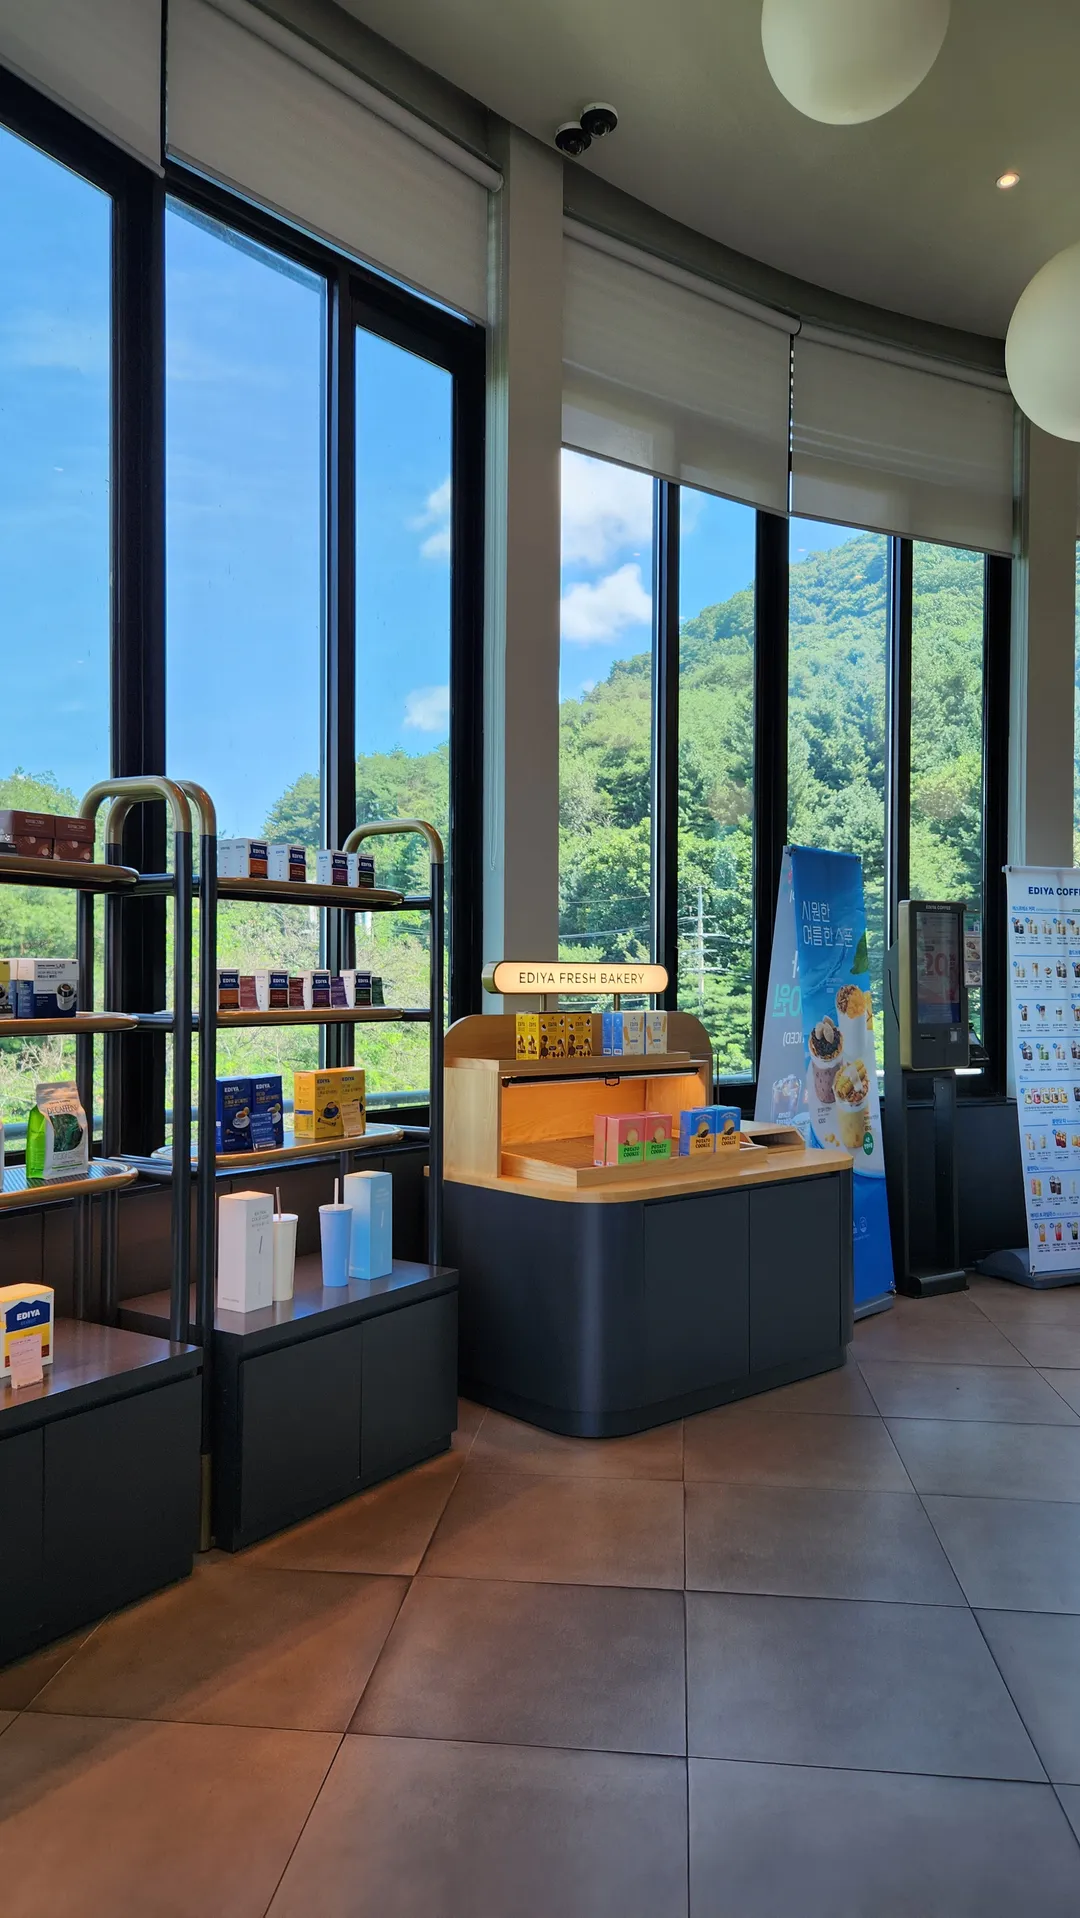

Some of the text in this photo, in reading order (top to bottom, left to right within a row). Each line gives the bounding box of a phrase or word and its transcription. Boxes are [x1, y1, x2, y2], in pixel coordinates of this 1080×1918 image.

[1028, 886, 1080, 896] EDIYA COFF
[802, 900, 830, 922] 시원한
[803, 925, 853, 948] 여름 한 스푼
[519, 972, 644, 984] EDIYA FRESH BAKERY
[16, 1308, 41, 1321] EDIYA
